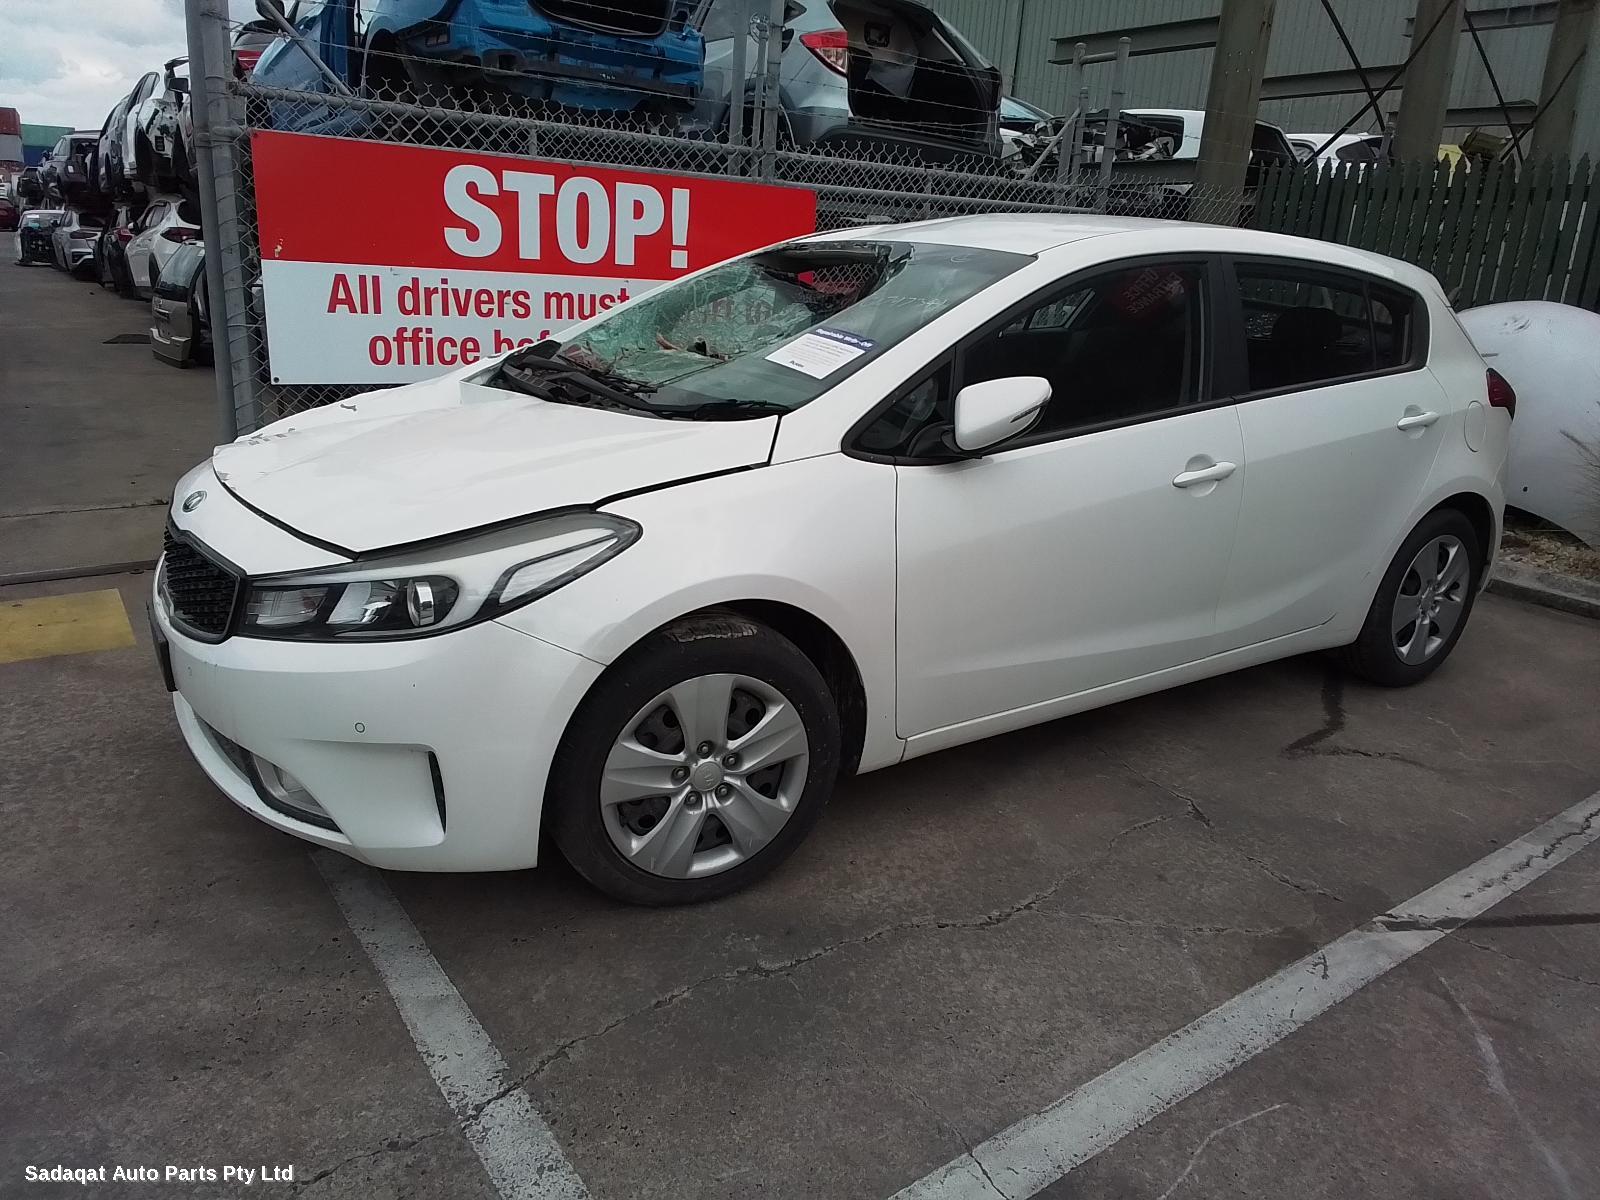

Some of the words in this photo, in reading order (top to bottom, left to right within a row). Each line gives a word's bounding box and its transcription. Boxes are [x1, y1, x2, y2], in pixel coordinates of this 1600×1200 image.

[443, 164, 690, 269] STOP!
[327, 273, 382, 314] All
[397, 277, 531, 319] drivers
[368, 326, 481, 366] office
